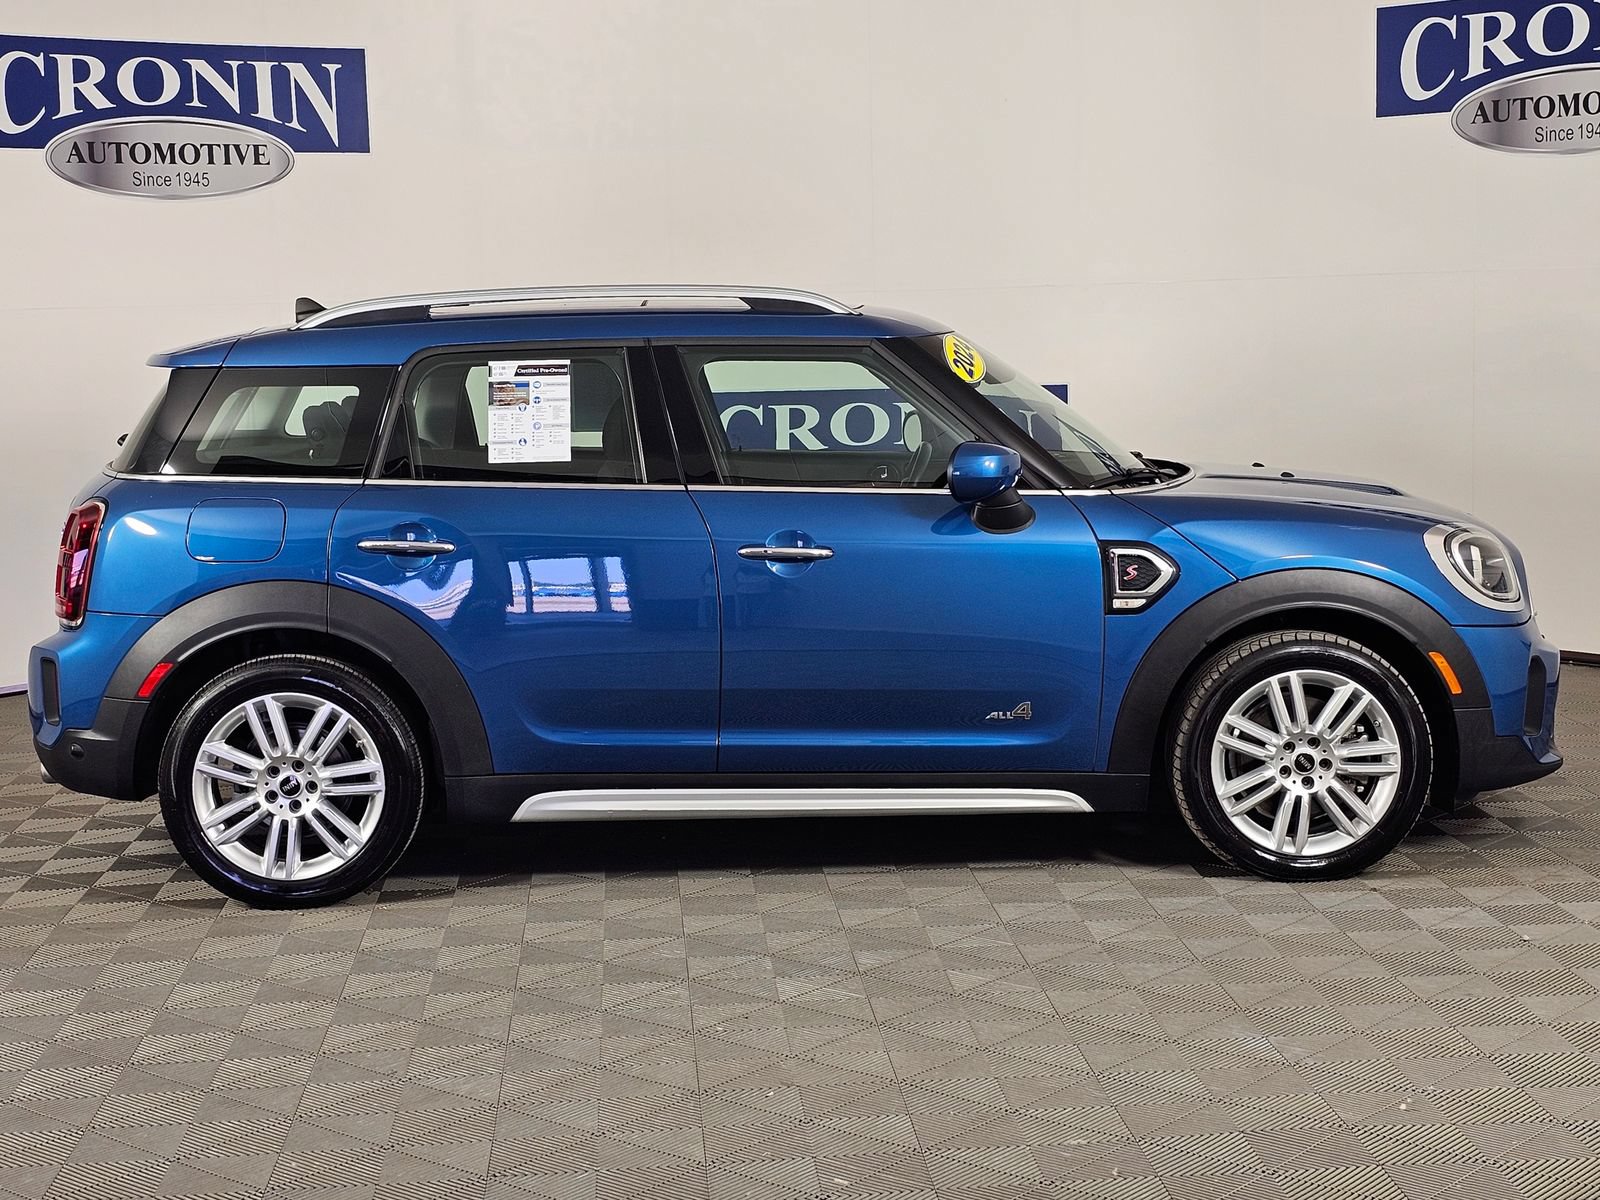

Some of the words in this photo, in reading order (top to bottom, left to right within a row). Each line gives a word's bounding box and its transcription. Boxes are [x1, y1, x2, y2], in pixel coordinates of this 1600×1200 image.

[1400, 0, 1600, 101] CRO
[0, 50, 342, 147] CRONIN
[1534, 126, 1574, 143] Since
[66, 141, 271, 165] AUTOMOTIVE
[132, 171, 172, 187] Since
[176, 172, 210, 187] 1945
[1123, 564, 1139, 581] S
